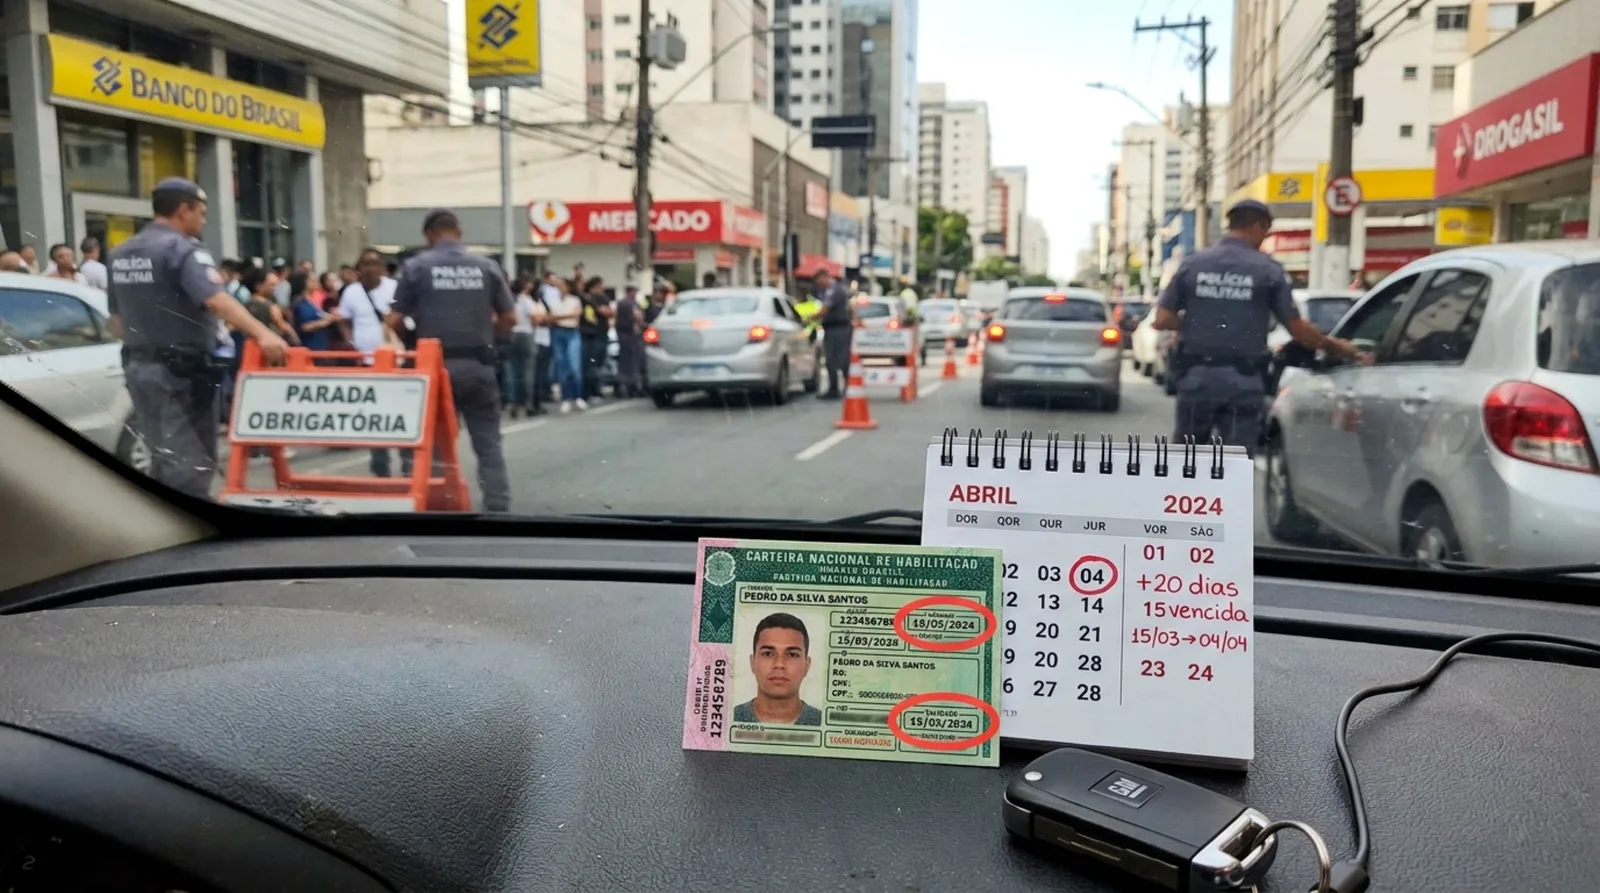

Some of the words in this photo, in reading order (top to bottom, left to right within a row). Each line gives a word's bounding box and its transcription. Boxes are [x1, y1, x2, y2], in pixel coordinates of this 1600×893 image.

[131, 67, 208, 113] BANCO
[211, 91, 238, 118] DO
[241, 94, 303, 132] BRASIL
[1473, 97, 1564, 162] DROGASIL
[588, 209, 711, 233] MERCADO
[286, 384, 377, 404] PARADA
[248, 408, 406, 433] OBRIGATÓRIA
[948, 484, 1017, 505] ABRIL
[1163, 495, 1223, 516] 2024
[955, 514, 978, 524] DOR
[996, 516, 1020, 527] QOR
[1039, 518, 1063, 529] QUR
[1083, 520, 1106, 531] JUR
[1144, 524, 1167, 535] VOR
[746, 550, 804, 563] CARTEIRA
[809, 553, 871, 567] NACIONAL
[1143, 544, 1165, 561] 01
[1189, 547, 1215, 564] 02
[1037, 565, 1061, 582] 03
[1080, 568, 1105, 585] 04
[1188, 573, 1239, 597] dias
[744, 591, 778, 602] PEDRO
[780, 593, 794, 602] DA
[796, 593, 826, 603] SILVA
[827, 595, 869, 605] SANTOS
[1037, 593, 1060, 610] 13
[1080, 597, 1104, 614] 14
[1143, 601, 1166, 618] 15
[1168, 602, 1250, 622] vencida
[1035, 622, 1059, 639] 20
[1079, 625, 1101, 642] 21
[1131, 626, 1180, 648] 15/03
[1199, 630, 1247, 653] 04/04
[863, 659, 875, 667] DA
[902, 662, 936, 670] SANTOS
[1034, 651, 1058, 668] 20
[1078, 654, 1102, 672] 28
[1140, 659, 1166, 678] 23
[1187, 663, 1214, 682] 24
[1033, 680, 1058, 698] 27
[1076, 683, 1101, 701] 28
